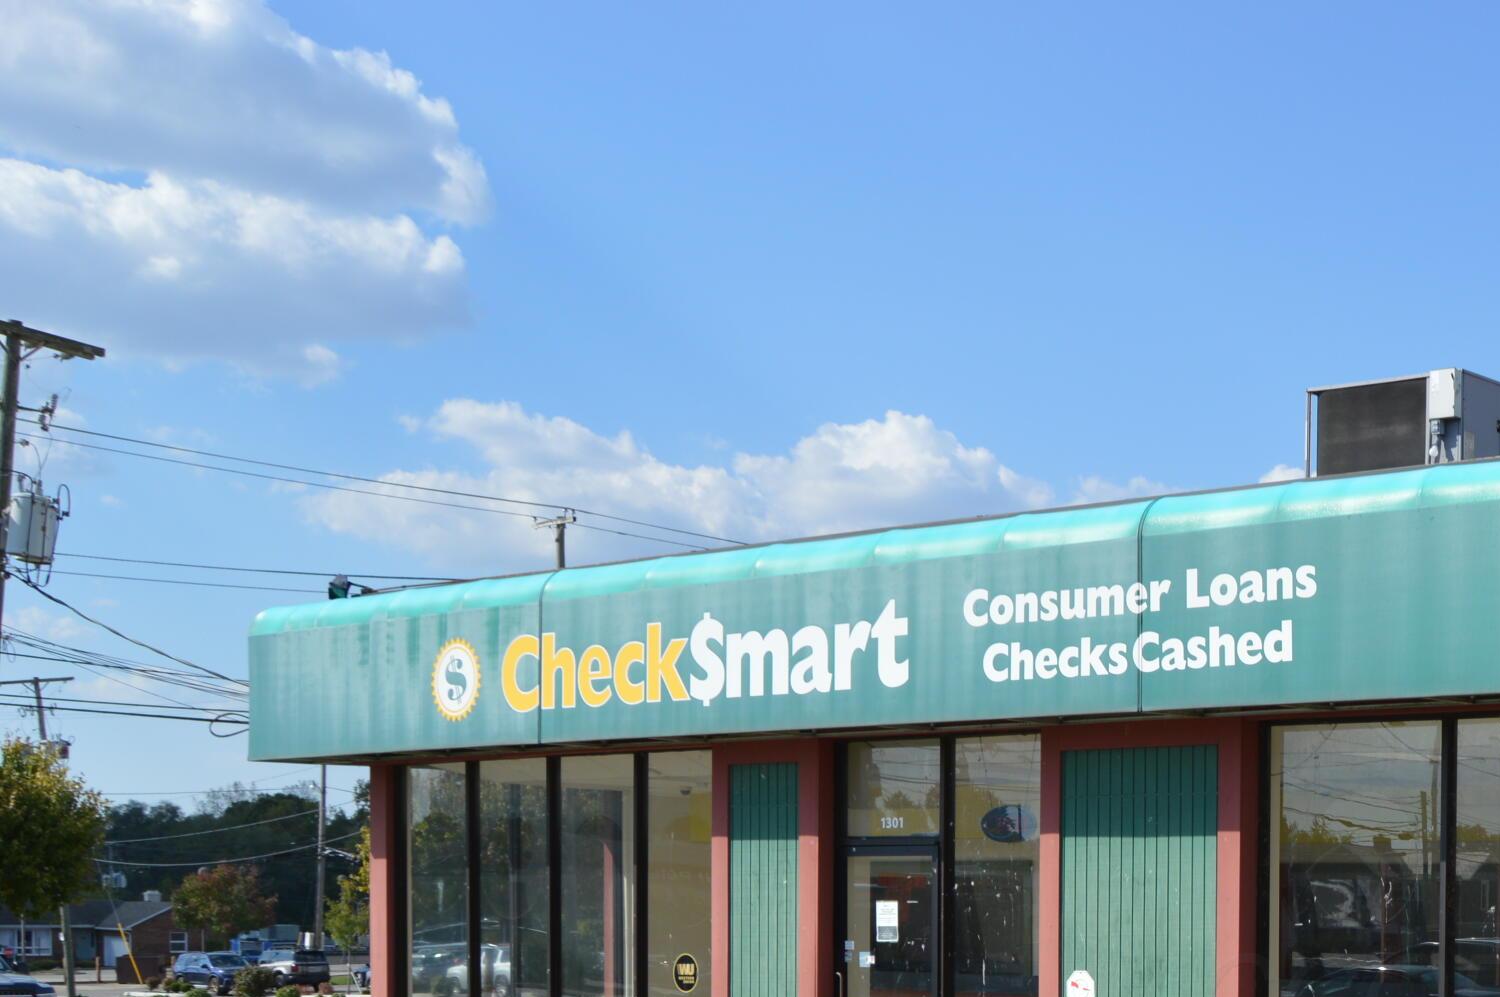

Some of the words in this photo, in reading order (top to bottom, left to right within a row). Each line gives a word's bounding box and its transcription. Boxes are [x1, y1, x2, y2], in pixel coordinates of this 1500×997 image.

[963, 578, 1171, 627] Consumer
[1186, 565, 1317, 608] Loans
[982, 637, 1128, 682] Checks
[1133, 620, 1293, 673] Cashed
[880, 816, 904, 829] 1301
